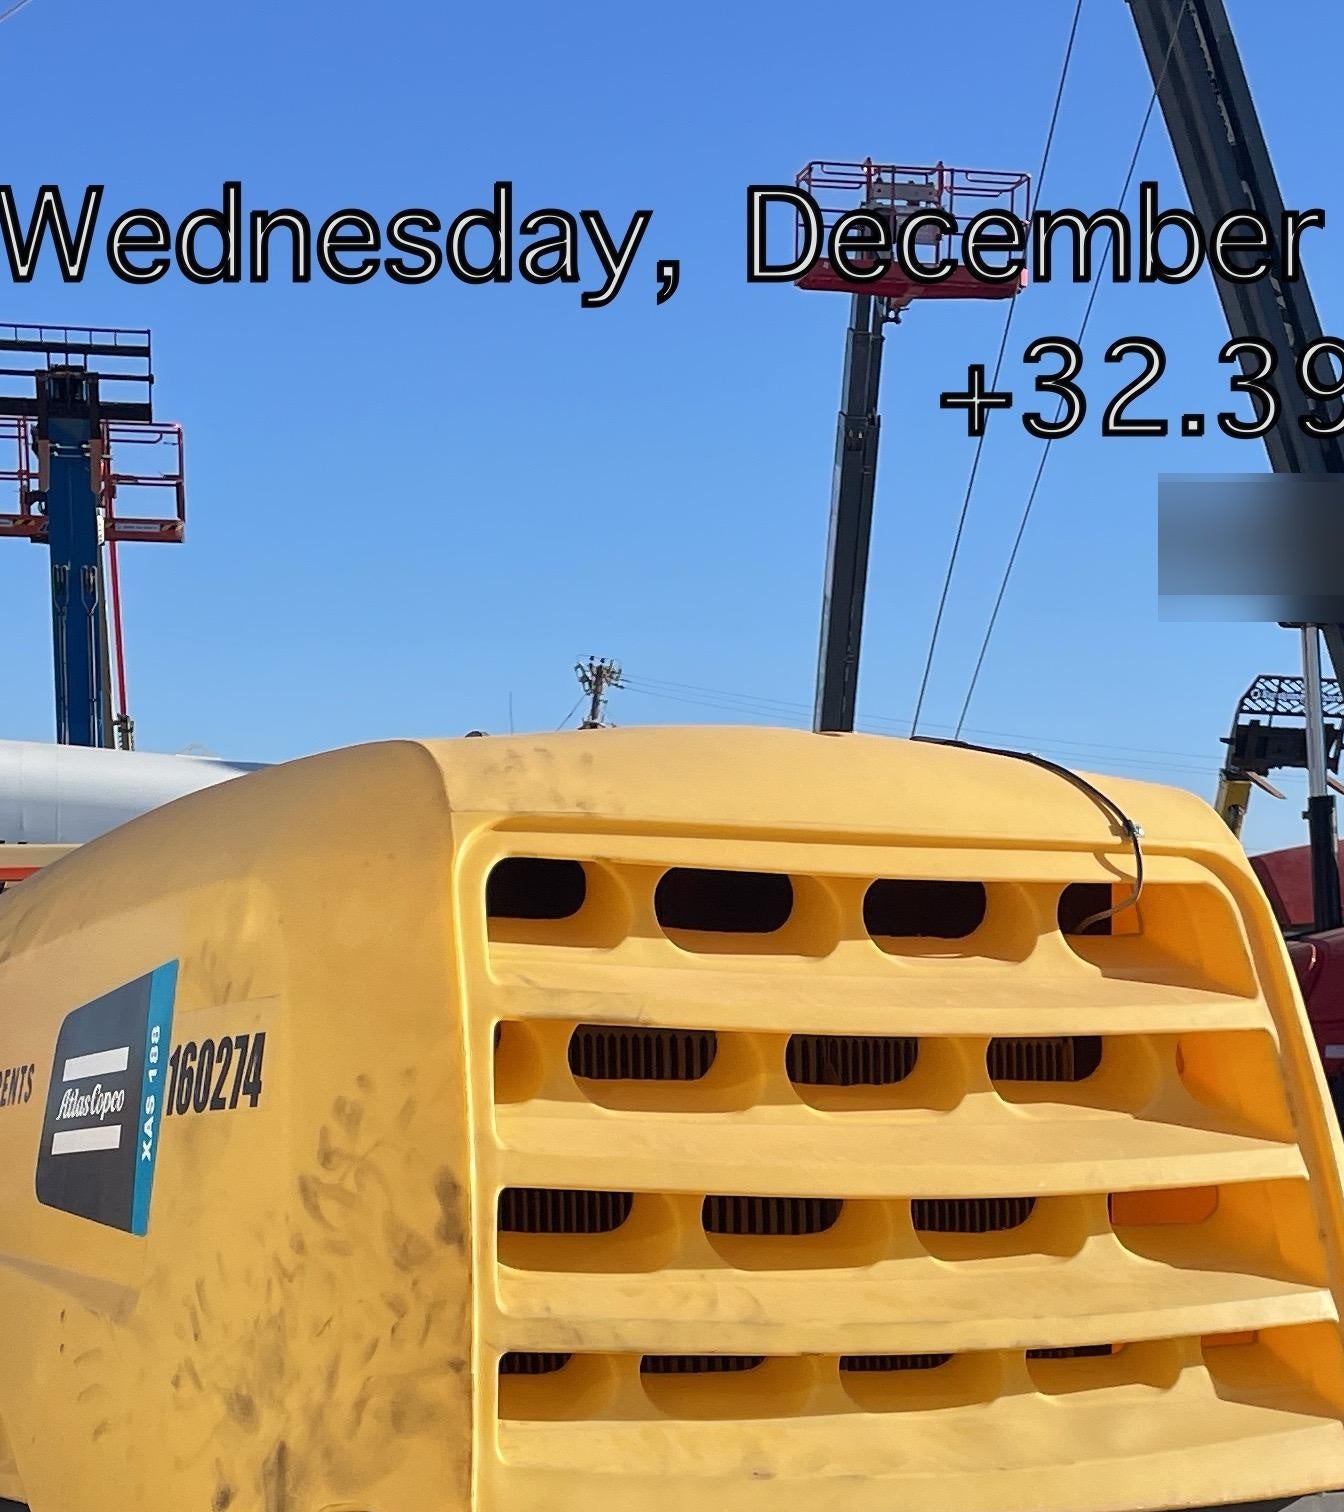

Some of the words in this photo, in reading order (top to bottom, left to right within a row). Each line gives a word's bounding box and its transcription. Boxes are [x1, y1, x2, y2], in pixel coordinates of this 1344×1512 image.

[148, 1025, 161, 1083] 188
[166, 1032, 267, 1116] 160274
[141, 1094, 156, 1162] XAS
